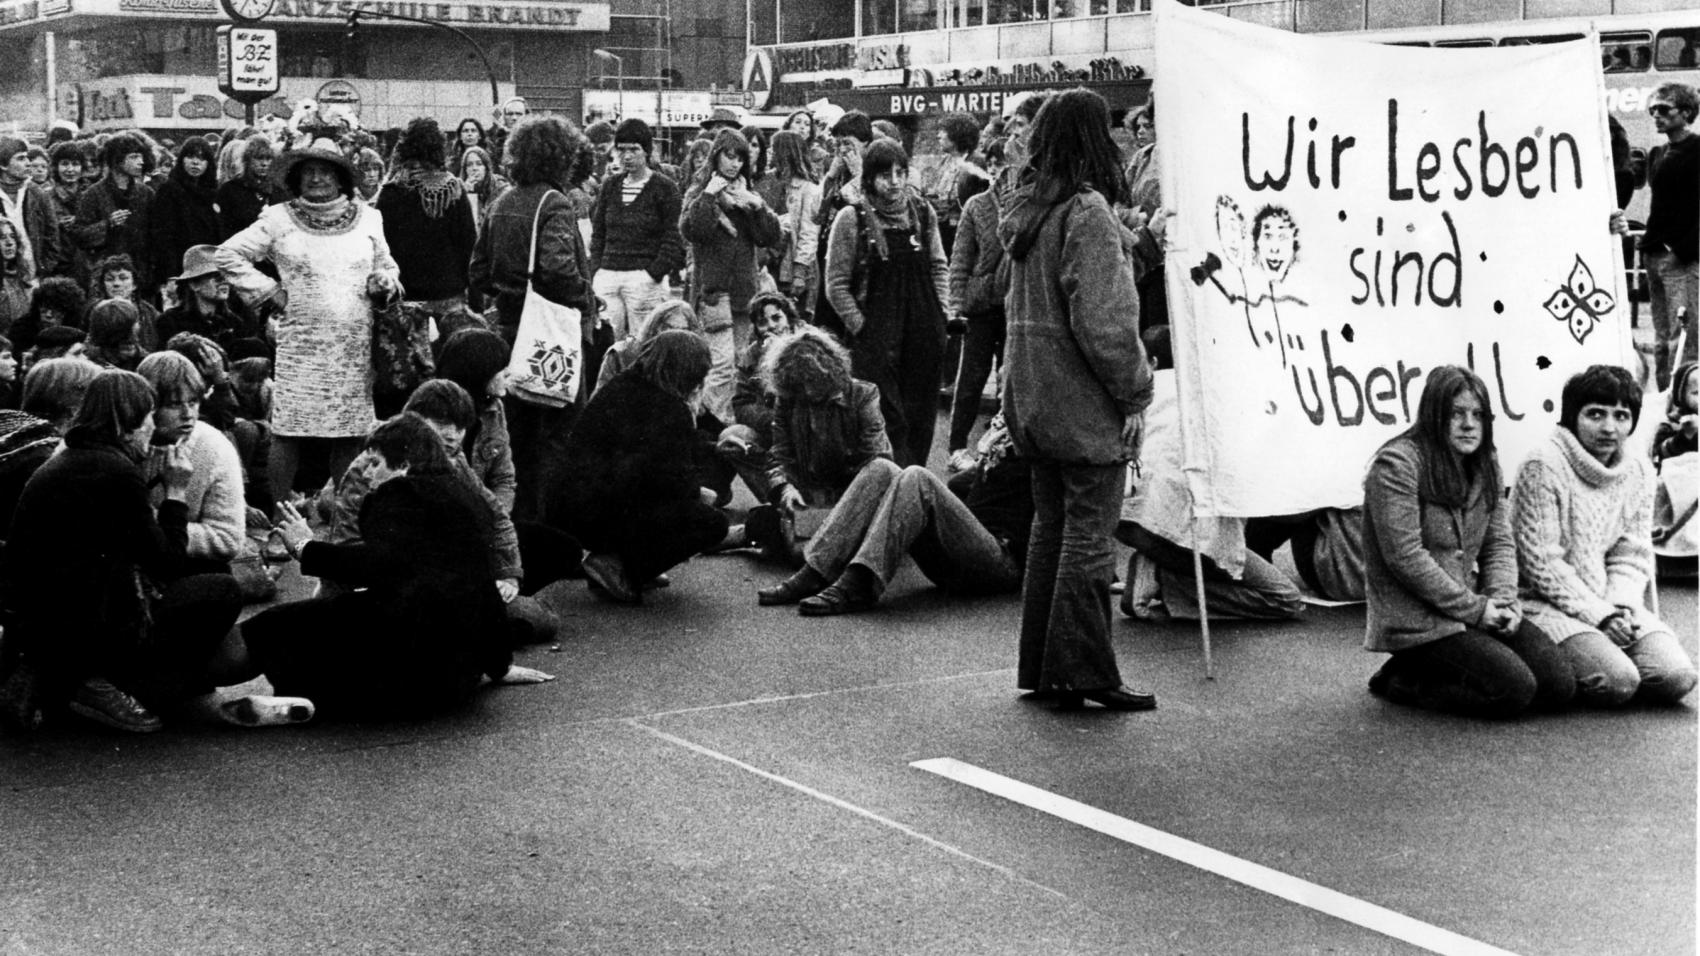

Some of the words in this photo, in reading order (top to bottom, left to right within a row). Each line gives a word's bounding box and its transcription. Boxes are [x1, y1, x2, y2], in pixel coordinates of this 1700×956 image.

[466, 5, 582, 25] BRANDT
[1242, 112, 1356, 192] Wir
[1388, 98, 1584, 203] Lesben
[1349, 210, 1463, 308] sind
[1287, 329, 1525, 427] überl
